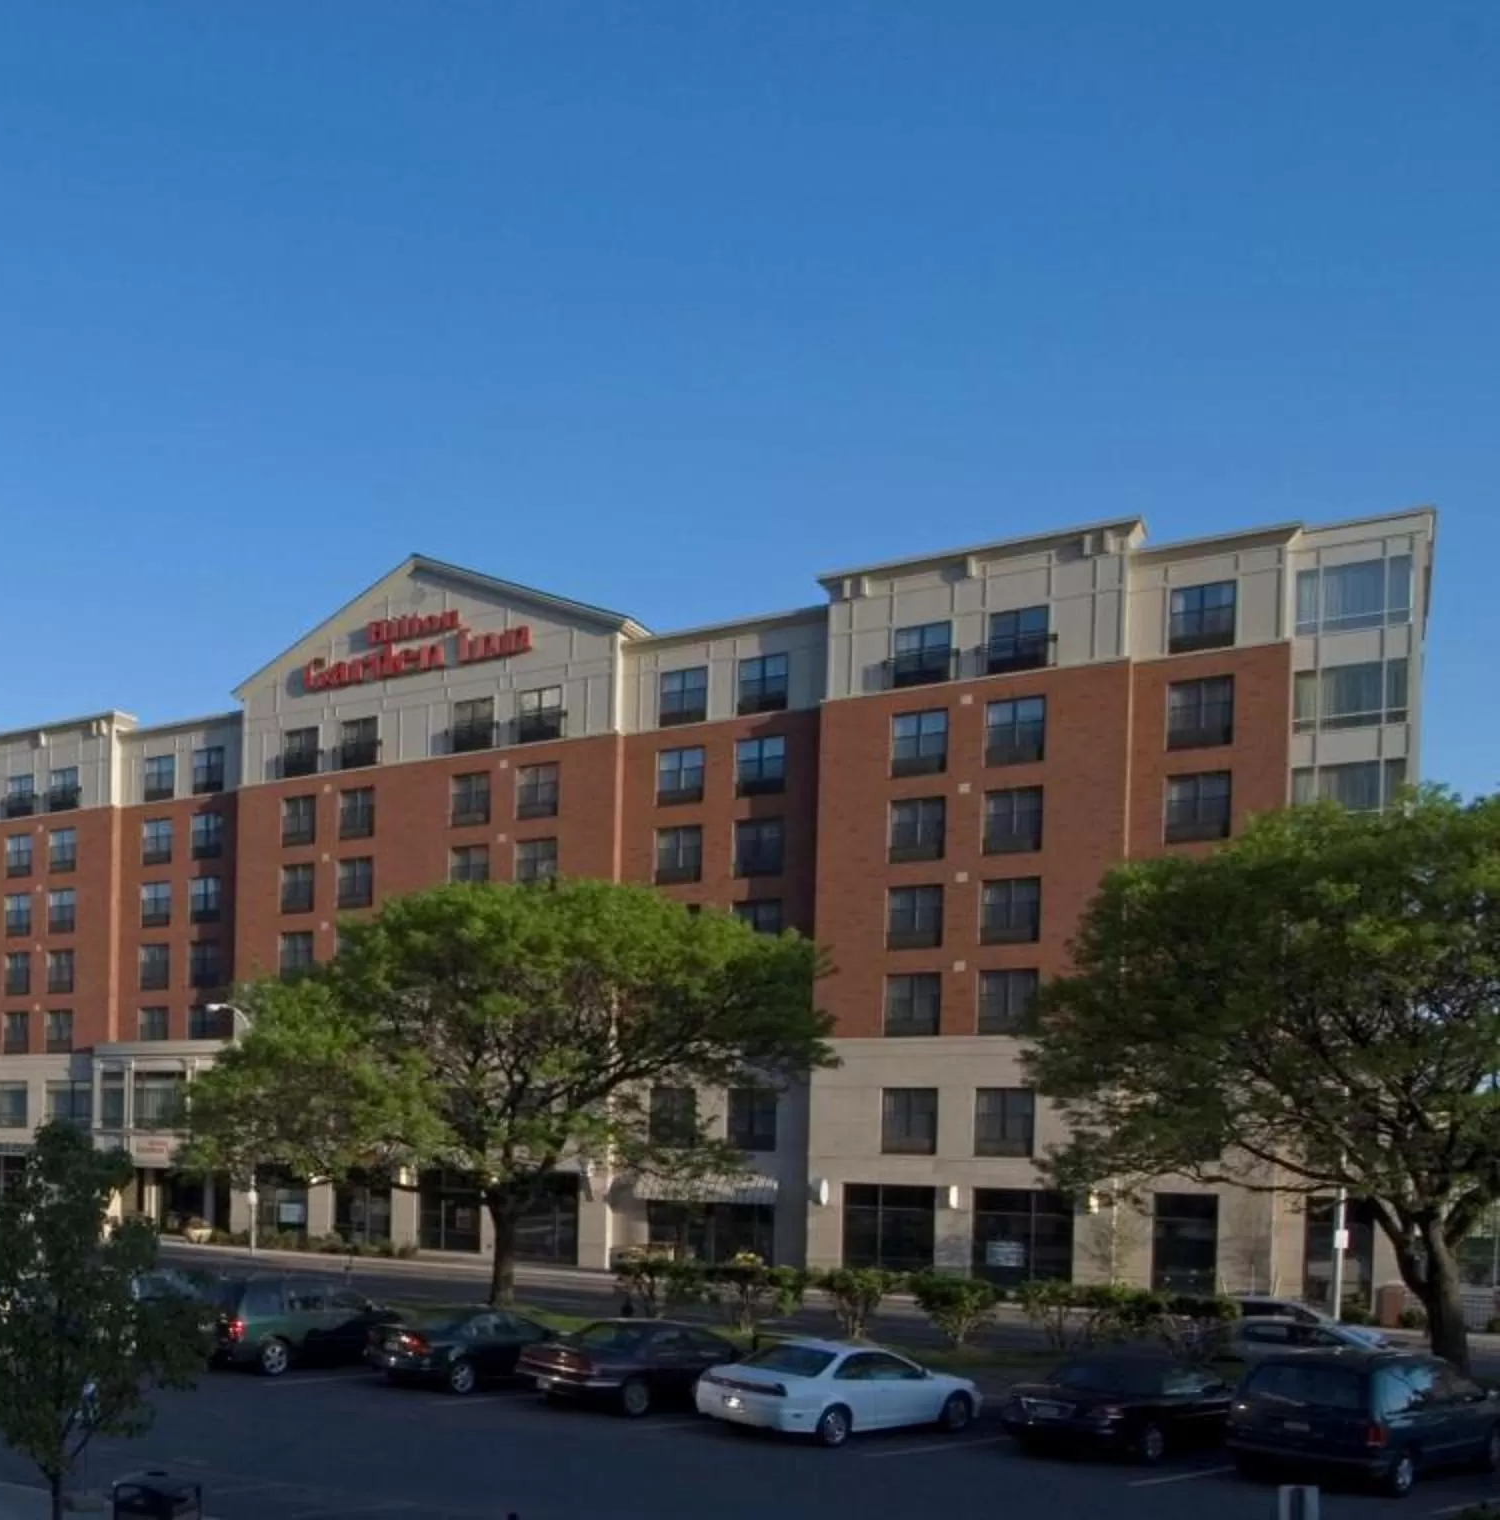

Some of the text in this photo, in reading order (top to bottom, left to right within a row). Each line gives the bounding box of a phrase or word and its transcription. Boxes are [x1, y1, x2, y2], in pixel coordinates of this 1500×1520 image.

[367, 610, 460, 646] Hilton
[303, 625, 533, 690] Garden Inn
